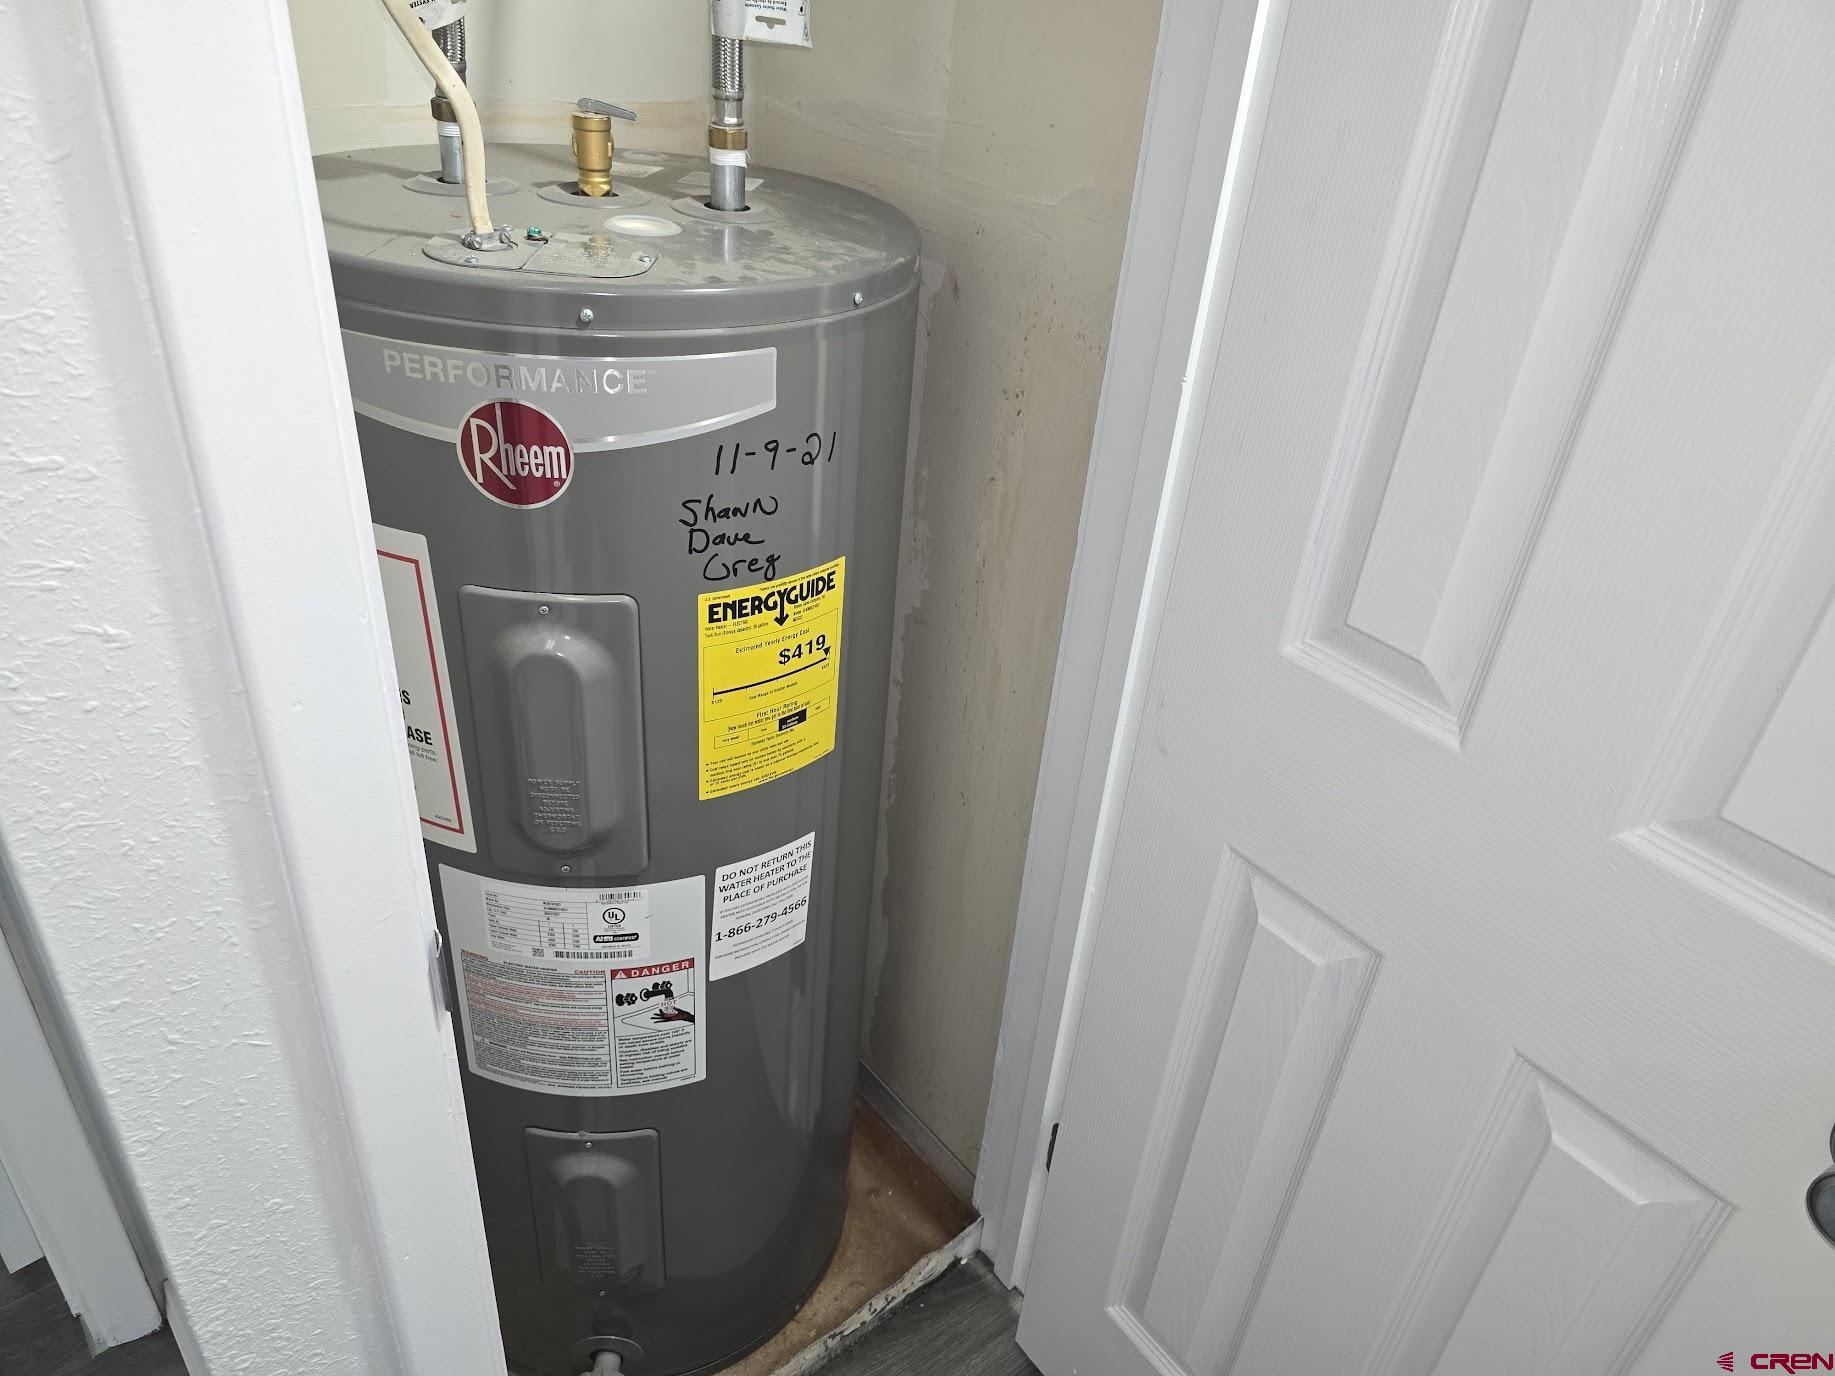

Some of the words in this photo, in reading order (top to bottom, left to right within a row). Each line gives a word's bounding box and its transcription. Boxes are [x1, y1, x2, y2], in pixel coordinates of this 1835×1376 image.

[383, 349, 647, 395] PERFORMANCE
[469, 402, 567, 491] Rheem
[714, 432, 837, 476] 11-9-21
[687, 527, 766, 555] Dave
[702, 553, 781, 582] Greg
[708, 570, 836, 624] ENERGYGUIDE
[736, 643, 763, 654] Estimated
[765, 638, 780, 648] Yearly
[782, 632, 798, 643] Energy
[800, 628, 810, 636] Cost
[779, 634, 826, 665] $419
[718, 879, 752, 893] WATER
[753, 864, 785, 882] HEATER
[786, 859, 797, 870] TO
[798, 851, 811, 863] THE
[722, 872, 737, 882] DO
[739, 864, 760, 878] NOT
[761, 850, 794, 869] RETURN
[796, 840, 812, 854] THIS
[723, 889, 751, 904] PLACE
[753, 884, 765, 894] OF
[766, 863, 808, 889] PURCHASE
[608, 911, 621, 921] UL
[715, 896, 807, 943] 1-866-279-4566
[631, 961, 689, 978] DANGER
